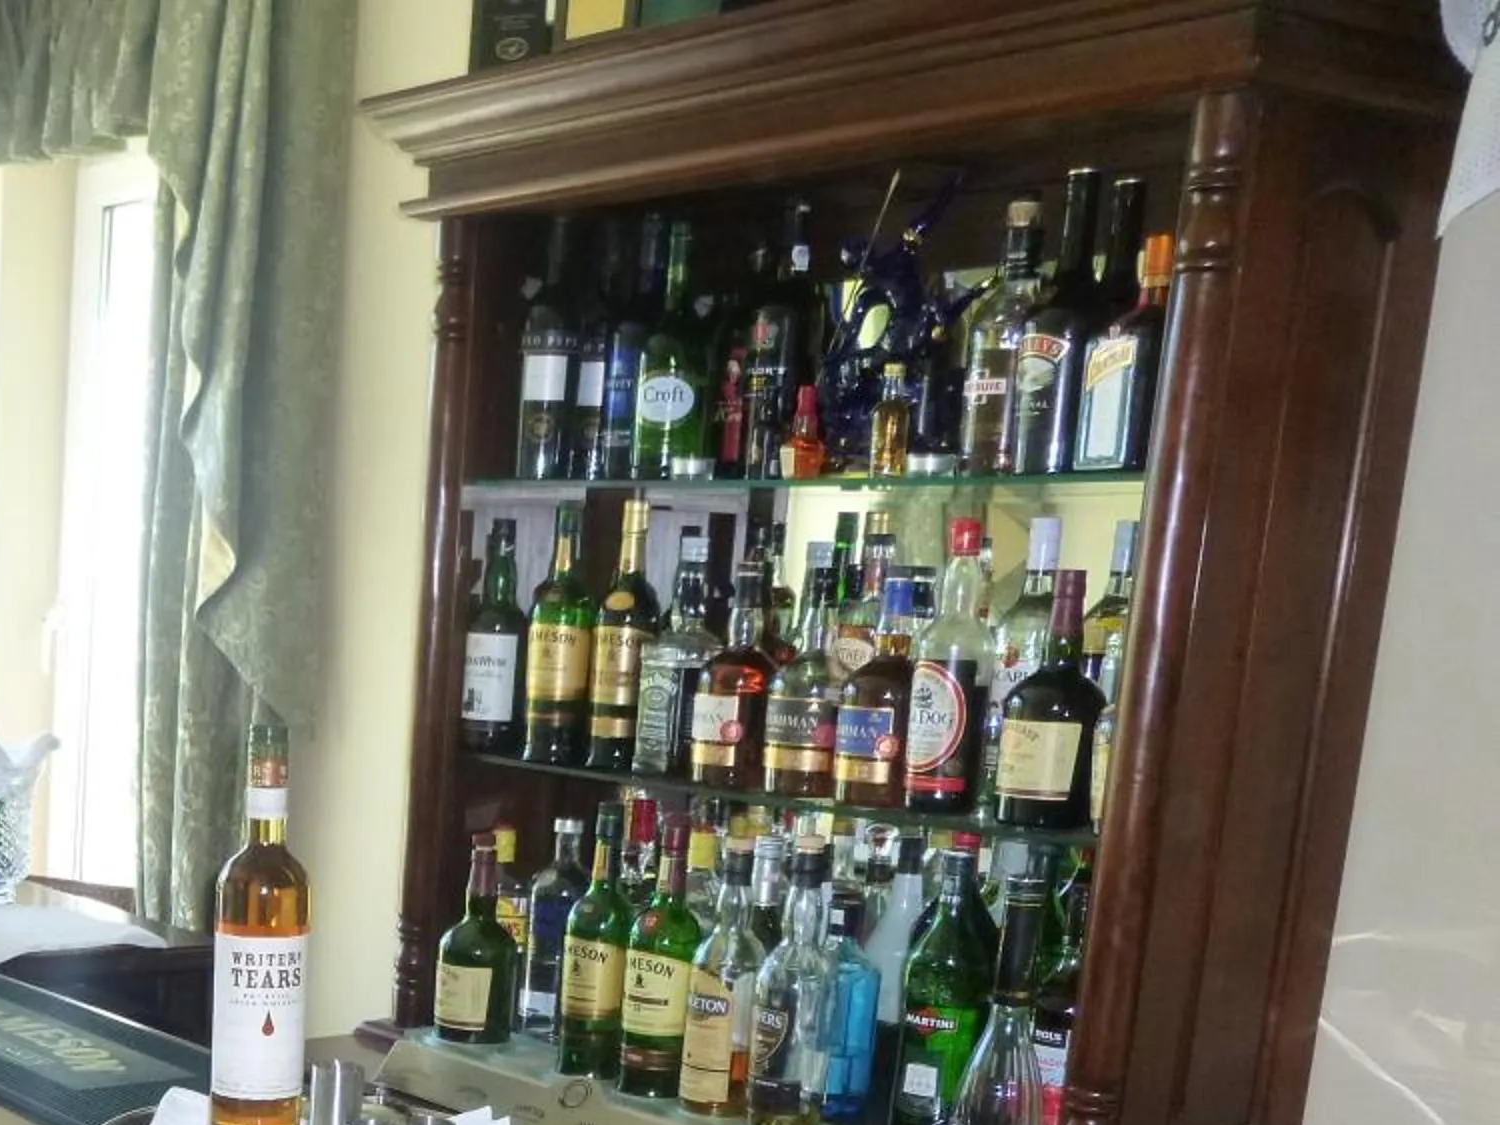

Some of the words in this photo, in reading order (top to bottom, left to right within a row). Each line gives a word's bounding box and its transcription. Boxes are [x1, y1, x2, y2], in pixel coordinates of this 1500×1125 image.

[644, 386, 684, 403] Croft
[232, 967, 301, 989] TEARS
[906, 1013, 957, 1030] MARTINI
